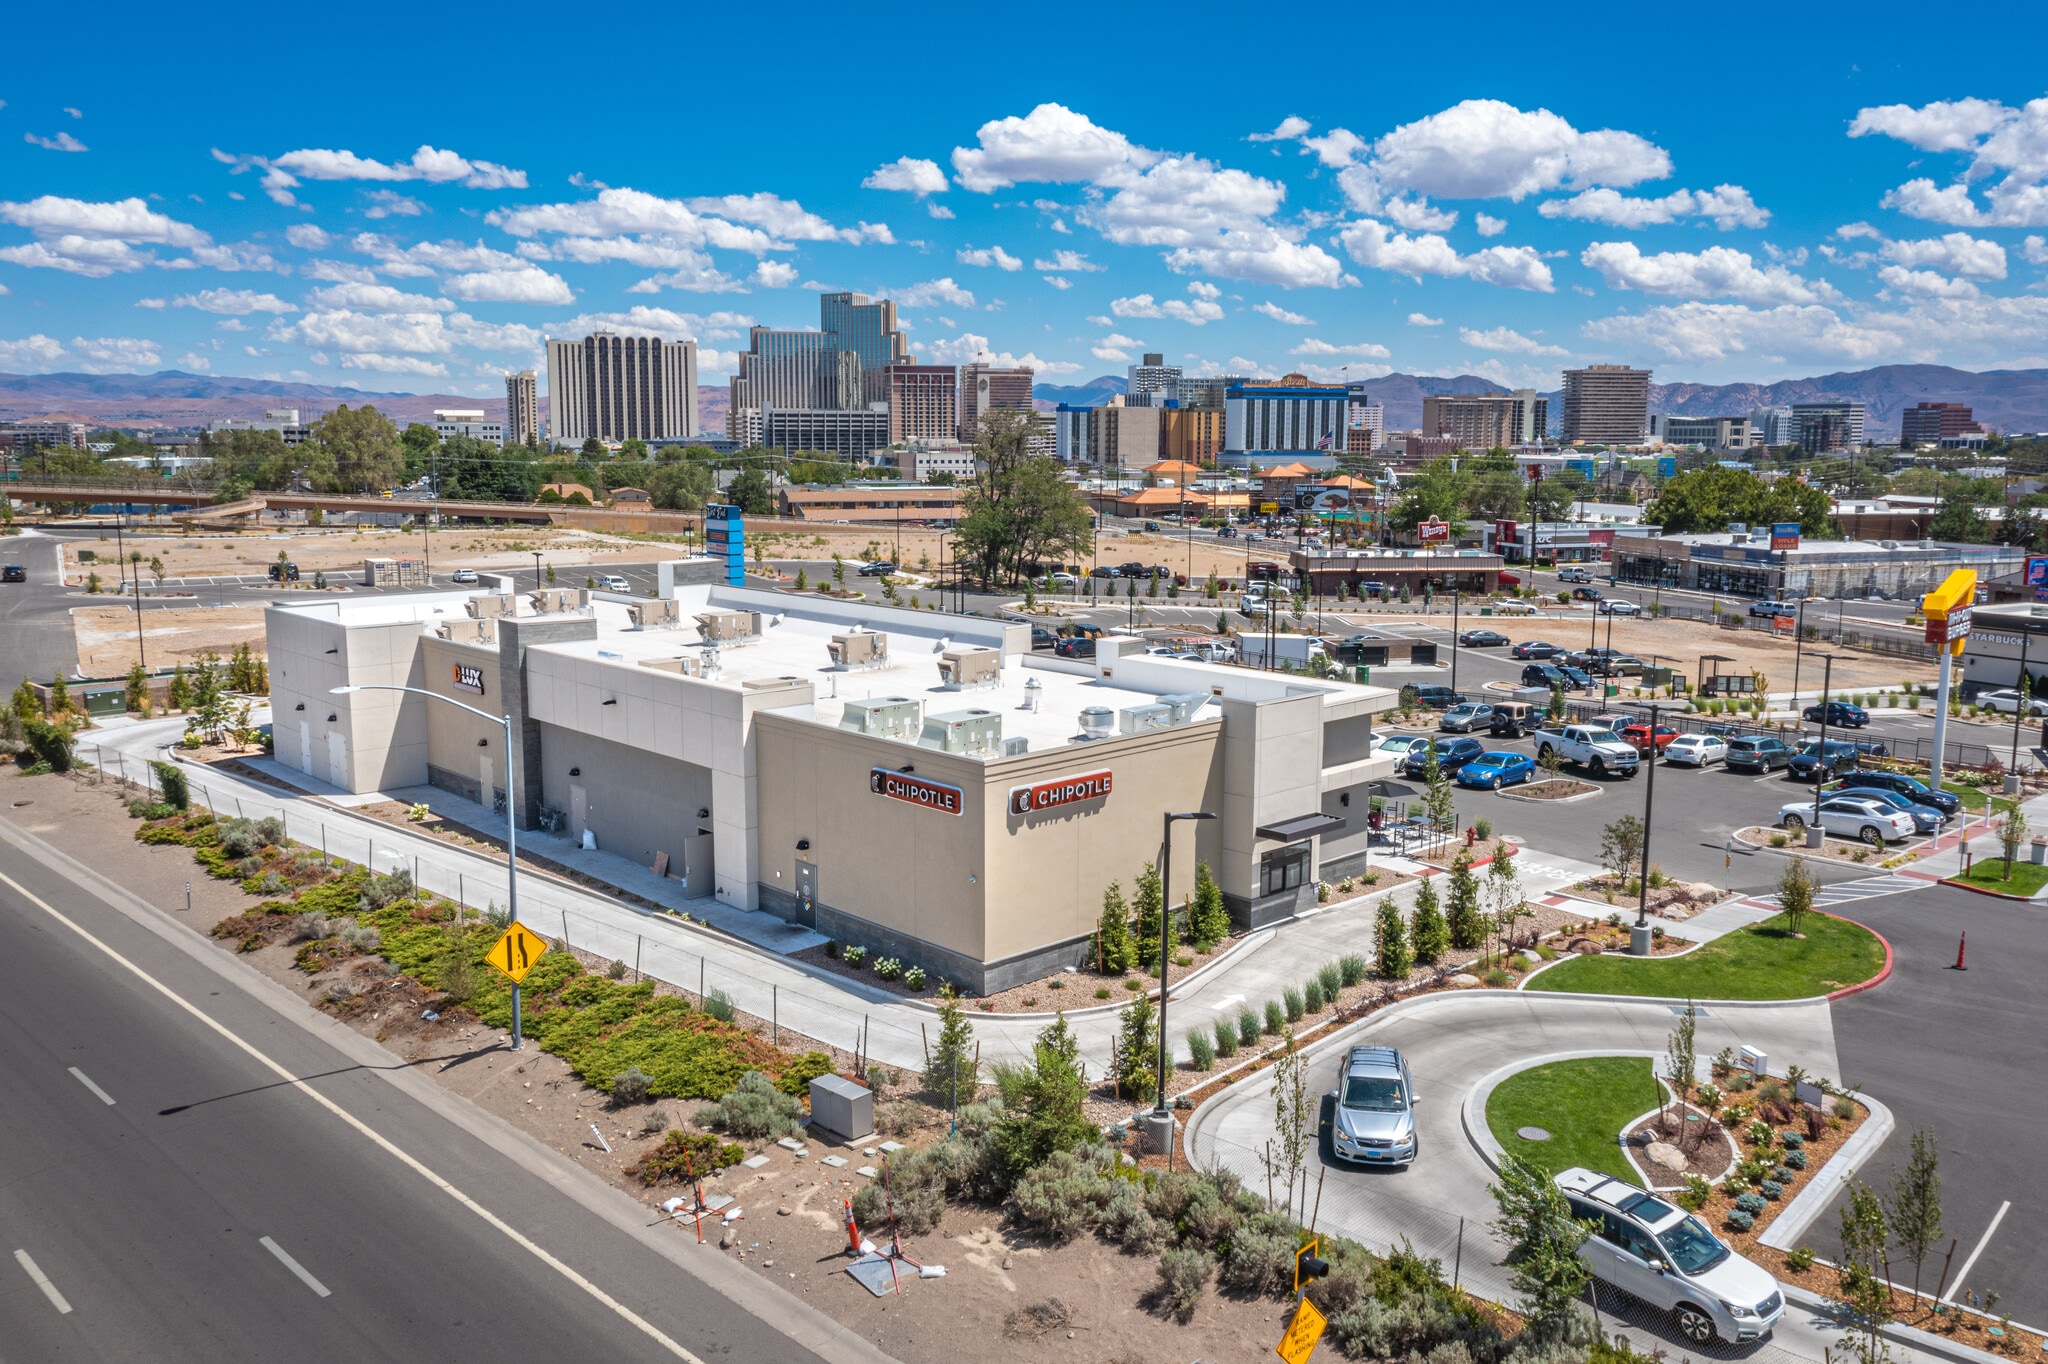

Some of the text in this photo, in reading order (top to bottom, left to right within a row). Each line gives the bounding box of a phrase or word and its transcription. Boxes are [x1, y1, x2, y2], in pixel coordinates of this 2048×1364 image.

[1969, 632, 2031, 647] STARBUCKS
[886, 779, 954, 809] CHIPOTLE
[1037, 776, 1111, 806] CHIPOTLE
[1296, 1311, 1311, 1326] RAMP
[1290, 1319, 1315, 1338] METERED
[1294, 1333, 1310, 1346] WHEN
[1287, 1339, 1315, 1360] FLASHING
